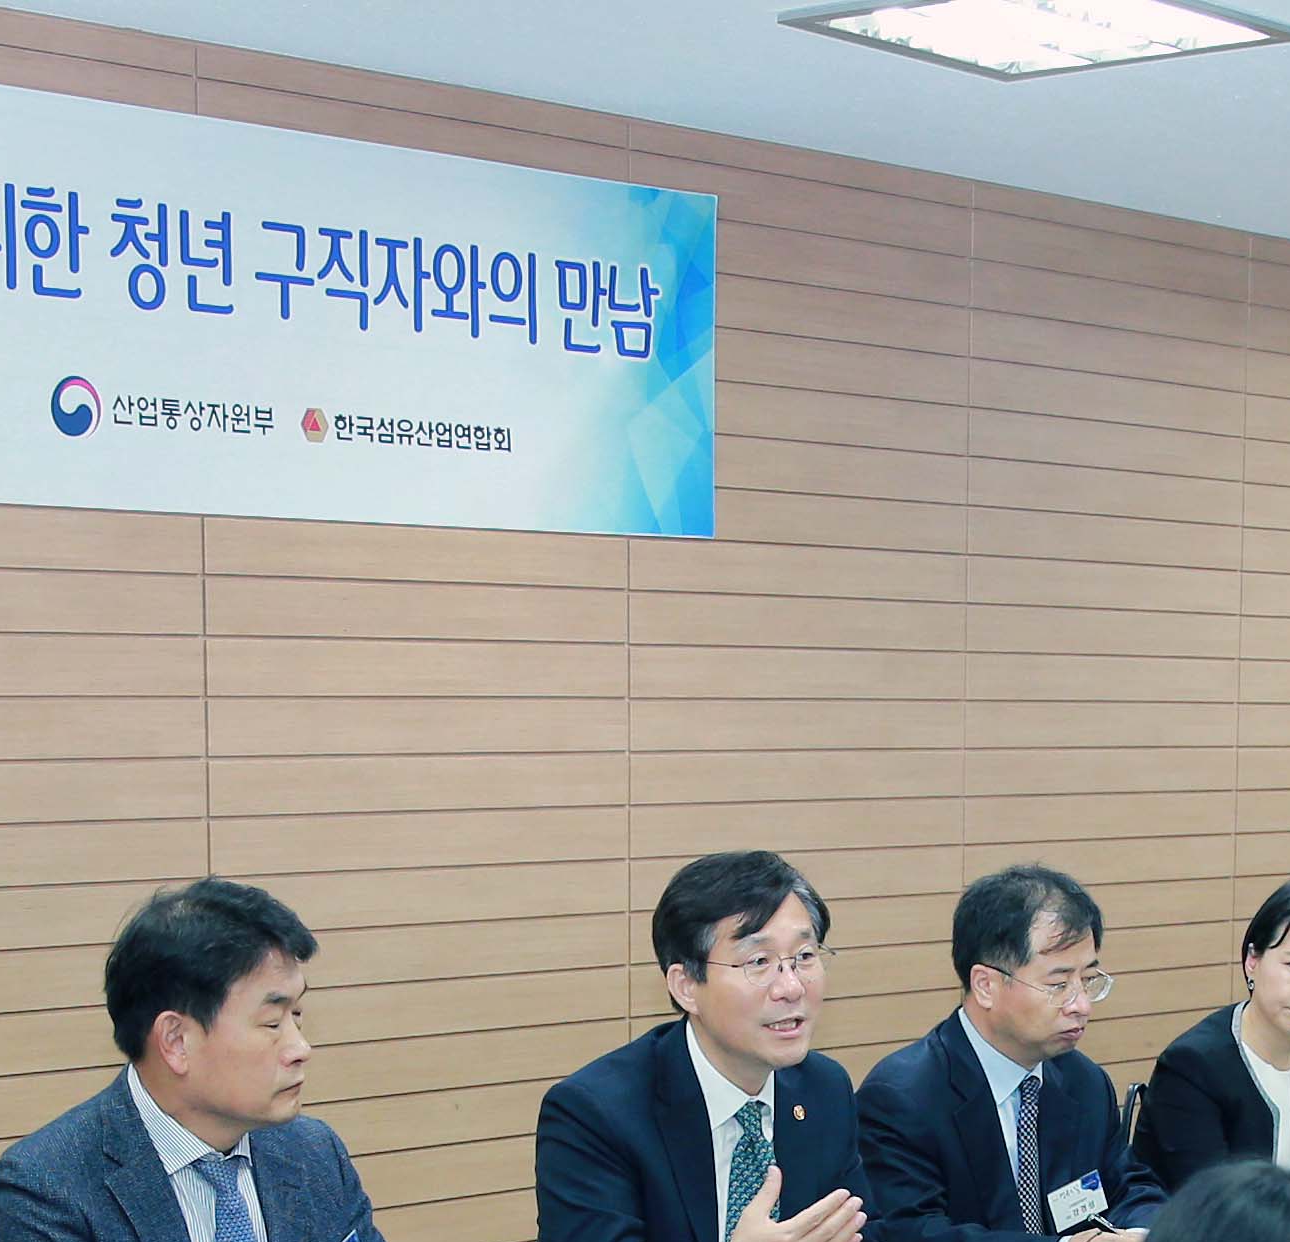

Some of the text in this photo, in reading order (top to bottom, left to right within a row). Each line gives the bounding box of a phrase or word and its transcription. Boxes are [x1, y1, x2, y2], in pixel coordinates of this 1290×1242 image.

[109, 197, 235, 316] 청년
[255, 219, 539, 346] 구직자와의
[553, 258, 661, 360] 만남
[111, 393, 275, 436] 산업통상자원부
[333, 412, 513, 453] 한국섬유산업연합회
